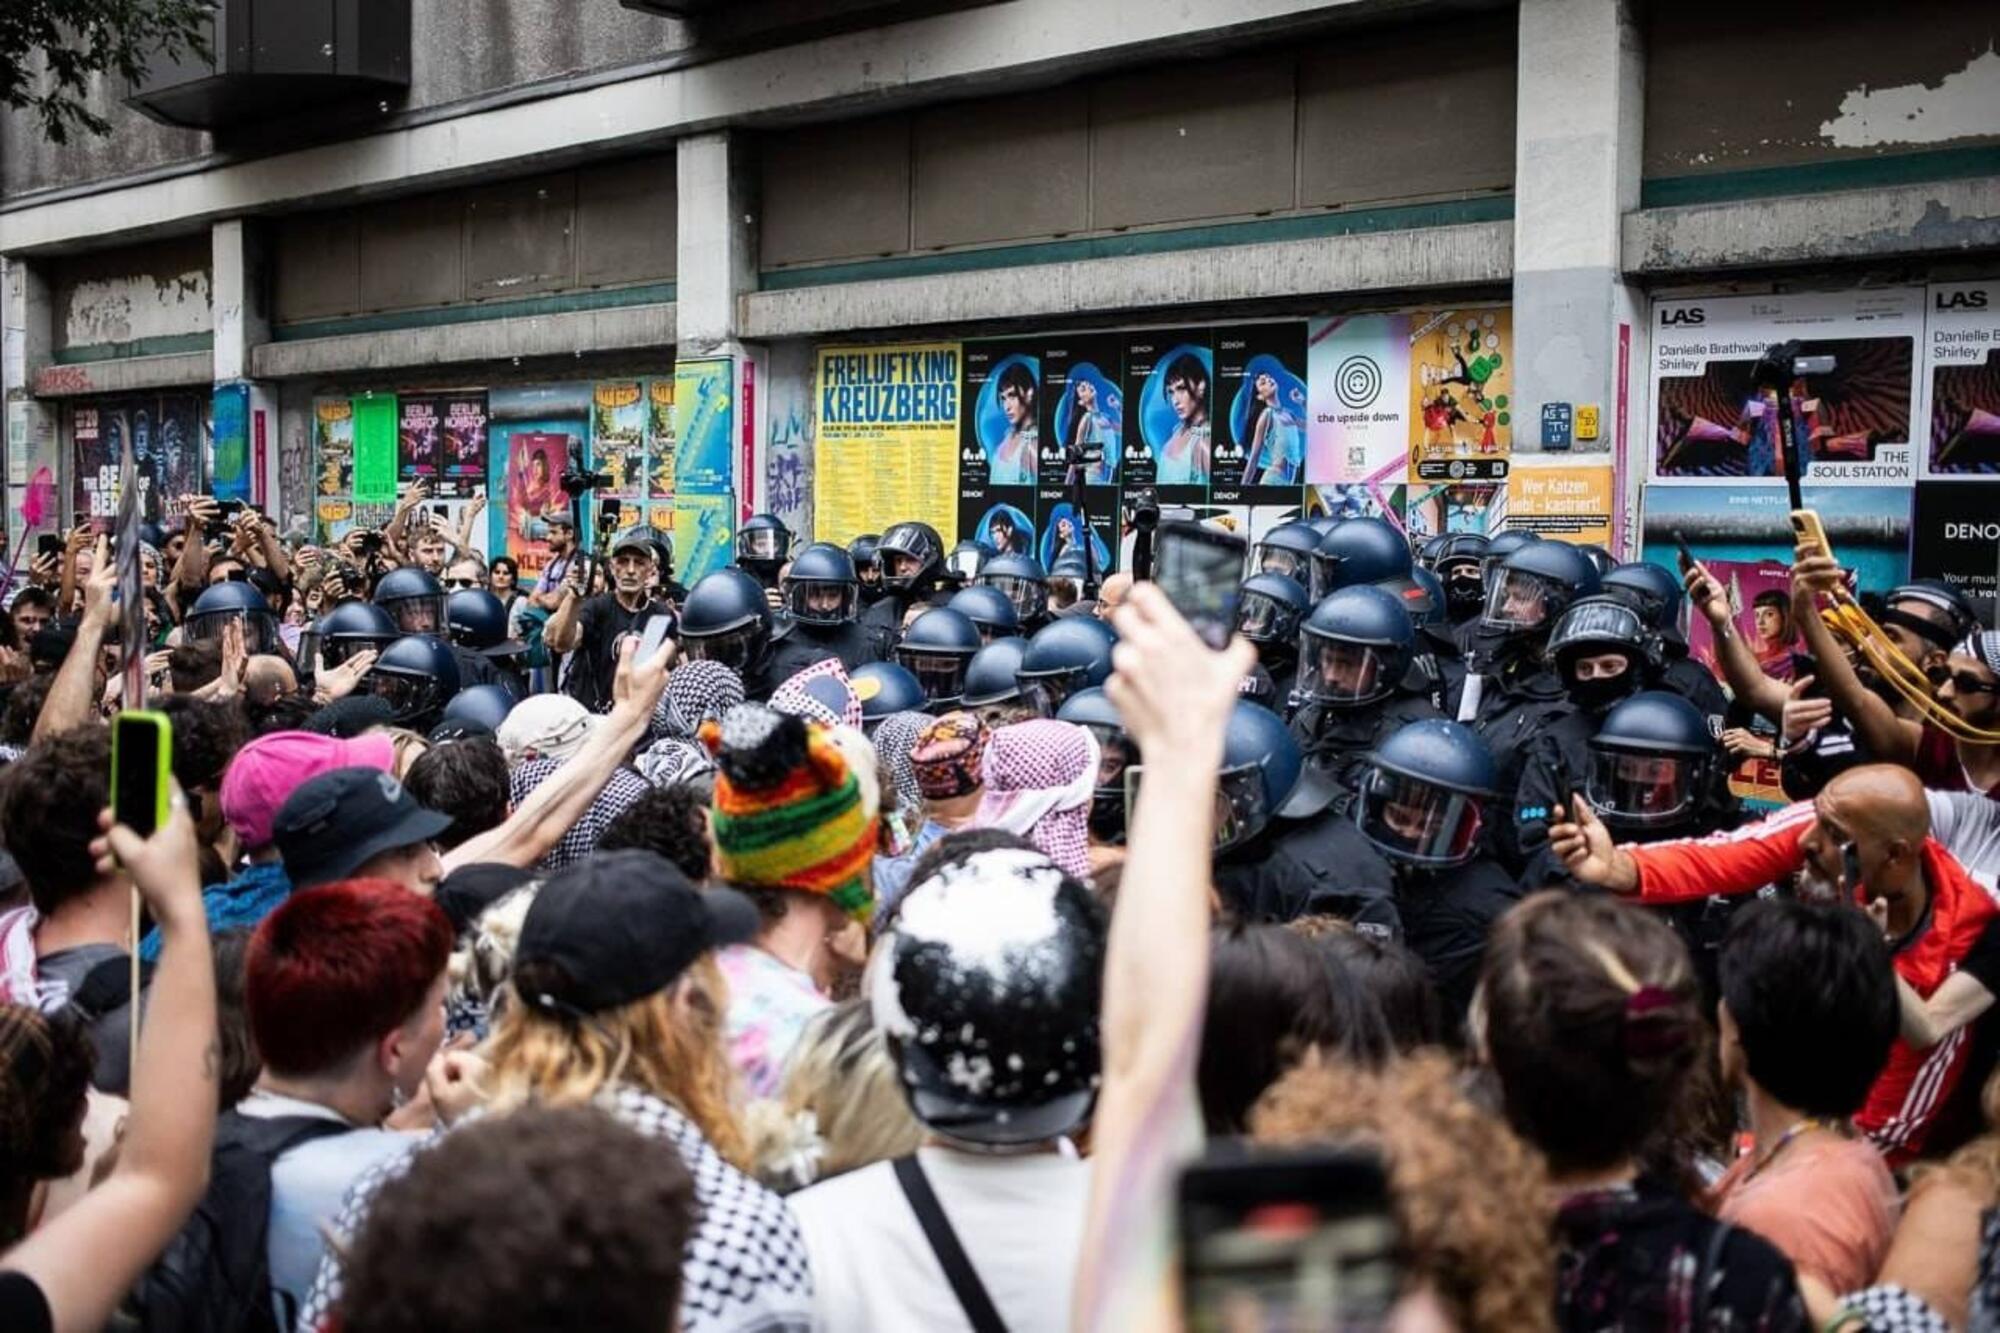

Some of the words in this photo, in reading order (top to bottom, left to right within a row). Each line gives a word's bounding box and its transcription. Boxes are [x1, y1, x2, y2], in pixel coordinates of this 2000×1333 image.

[1936, 290, 1988, 308] LAS
[1661, 308, 1705, 324] LAS
[1934, 330, 1989, 343] Danielle
[1659, 344, 1707, 356] Danielle
[1934, 346, 1980, 360] Shirley
[823, 350, 957, 386] FREILUFTKINO
[1659, 359, 1700, 371] Shirley
[823, 383, 957, 424] KREUZBERG
[1317, 414, 1335, 423] the
[1337, 412, 1370, 425] upside
[1372, 411, 1399, 422] down
[1882, 451, 1910, 463] THE
[1813, 466, 1849, 478] SOUL
[1852, 466, 1909, 478] STATION
[517, 553, 552, 571] KLE
[1942, 572, 1968, 584] Your
